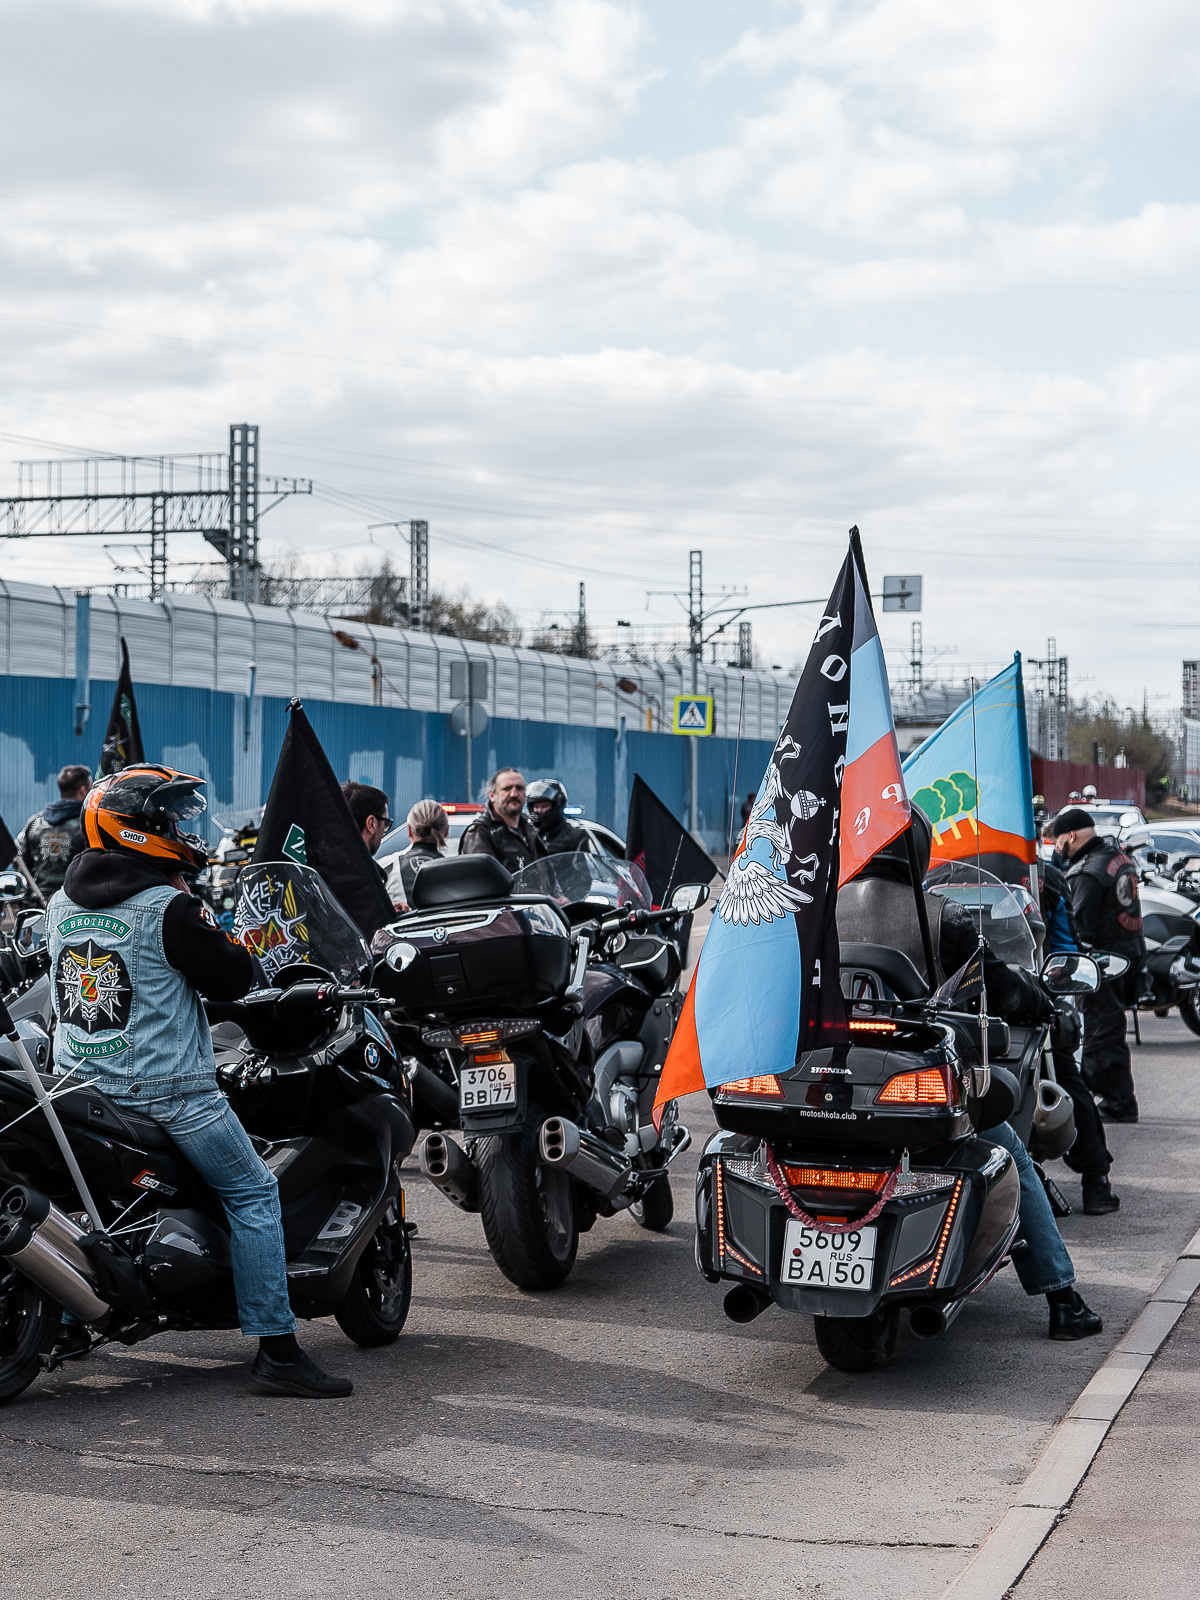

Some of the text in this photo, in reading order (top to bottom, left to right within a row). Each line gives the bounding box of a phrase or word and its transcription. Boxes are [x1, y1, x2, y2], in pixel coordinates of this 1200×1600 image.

[123, 831, 144, 842] SHOEI
[60, 917, 125, 934] Z-BROTHERS
[82, 975, 98, 998] Z
[468, 1067, 506, 1084] 3706
[810, 1067, 852, 1075] HONDA
[493, 1087, 512, 1102] 77
[800, 1110, 857, 1120] motoshkola.club
[799, 1227, 861, 1252] 5609
[830, 1252, 853, 1261] RUS
[835, 1262, 864, 1285] 50
